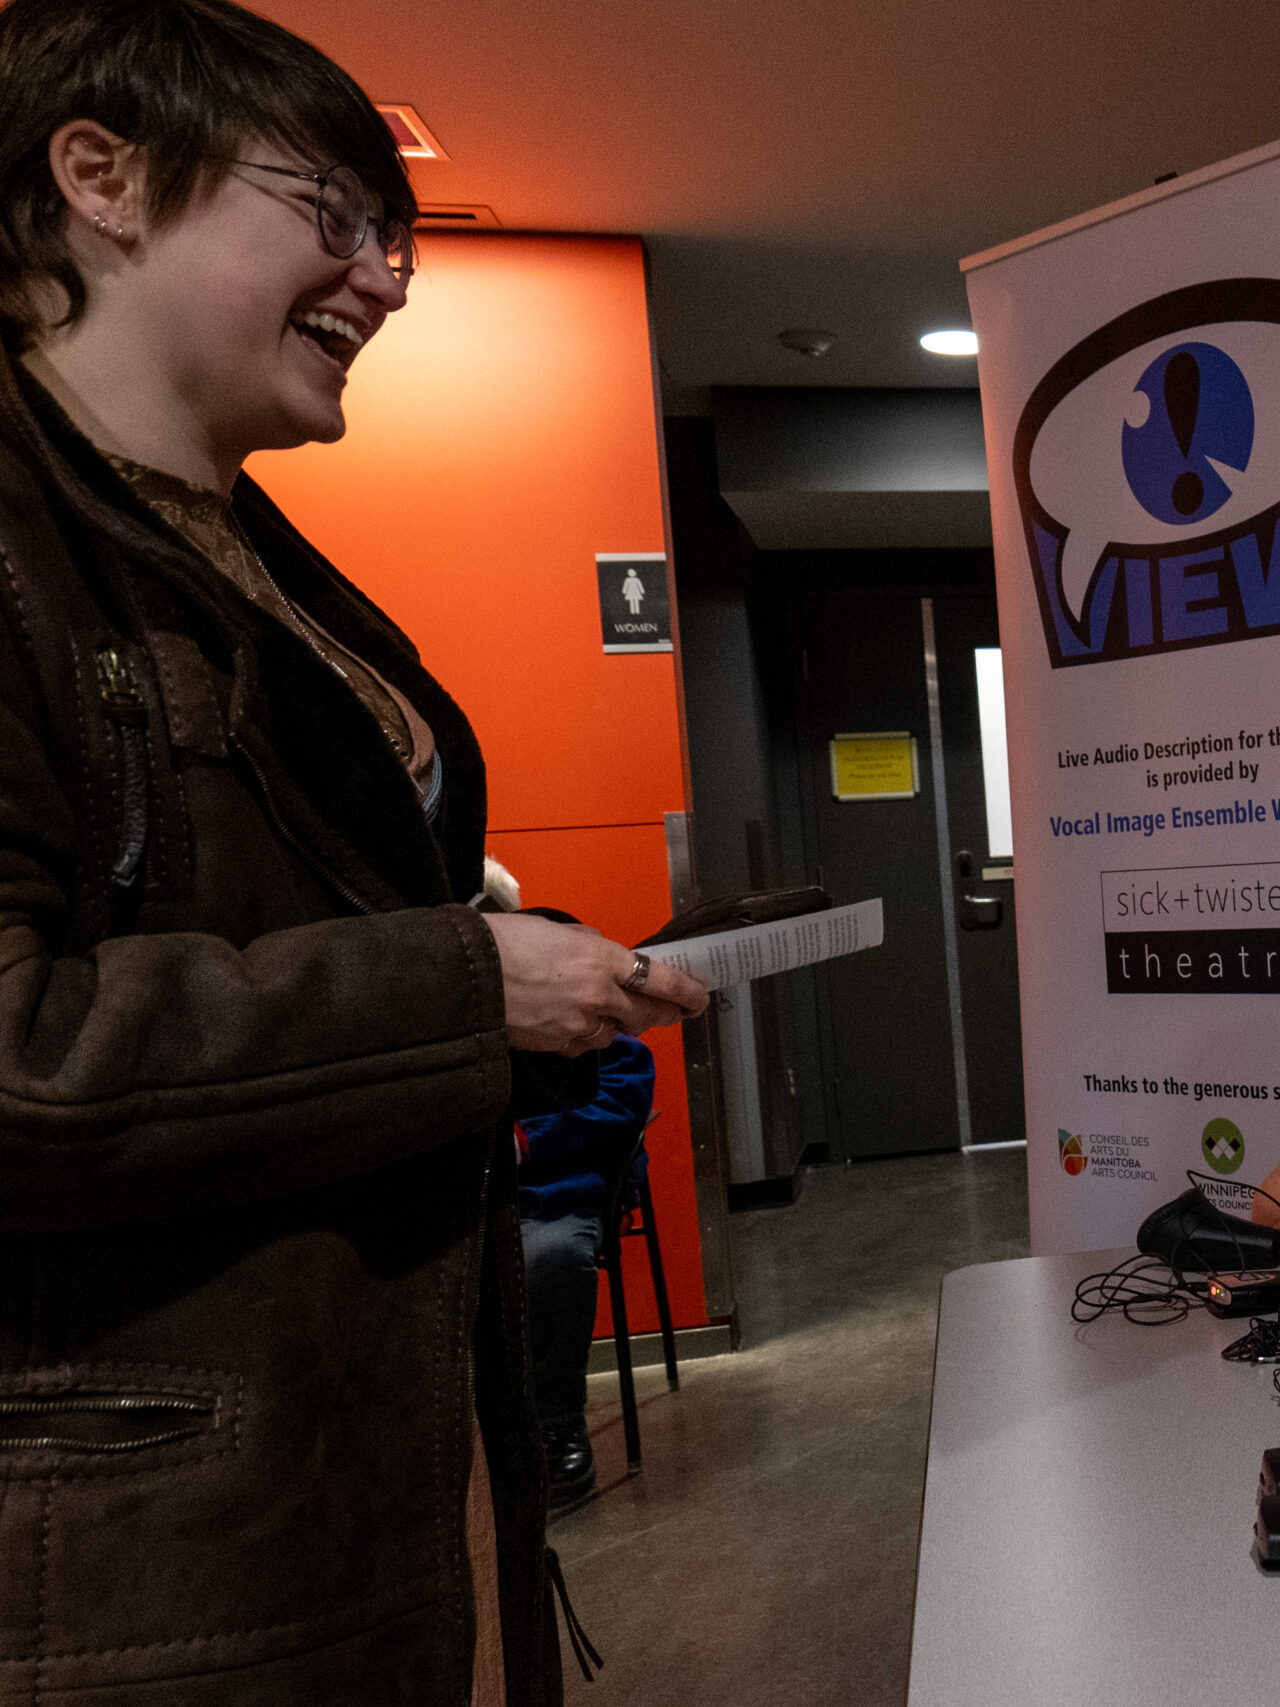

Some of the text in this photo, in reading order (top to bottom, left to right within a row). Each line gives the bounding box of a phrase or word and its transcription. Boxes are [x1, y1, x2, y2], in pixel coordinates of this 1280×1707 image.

[614, 623, 658, 633] WOMEN
[1058, 751, 1089, 768] Live
[1093, 744, 1139, 765] Audio
[1144, 734, 1234, 760] Description
[1238, 730, 1263, 749] for
[1147, 760, 1259, 791] is provided by
[1050, 812, 1100, 837] Vocal
[1106, 812, 1165, 837] Image
[1172, 800, 1266, 829] Ensemble
[1083, 1074, 1138, 1093] Thanks
[1142, 1078, 1158, 1094] to
[1163, 1076, 1188, 1096] the
[1194, 1082, 1268, 1101] generous
[1089, 1134, 1150, 1147] CONSEIL DES
[1090, 1146, 1129, 1157] ARTS DU
[1091, 1158, 1141, 1169] MANITOBA
[1092, 1168, 1159, 1181] ARTS COUNCIL
[1218, 1199, 1253, 1211] COUNC
